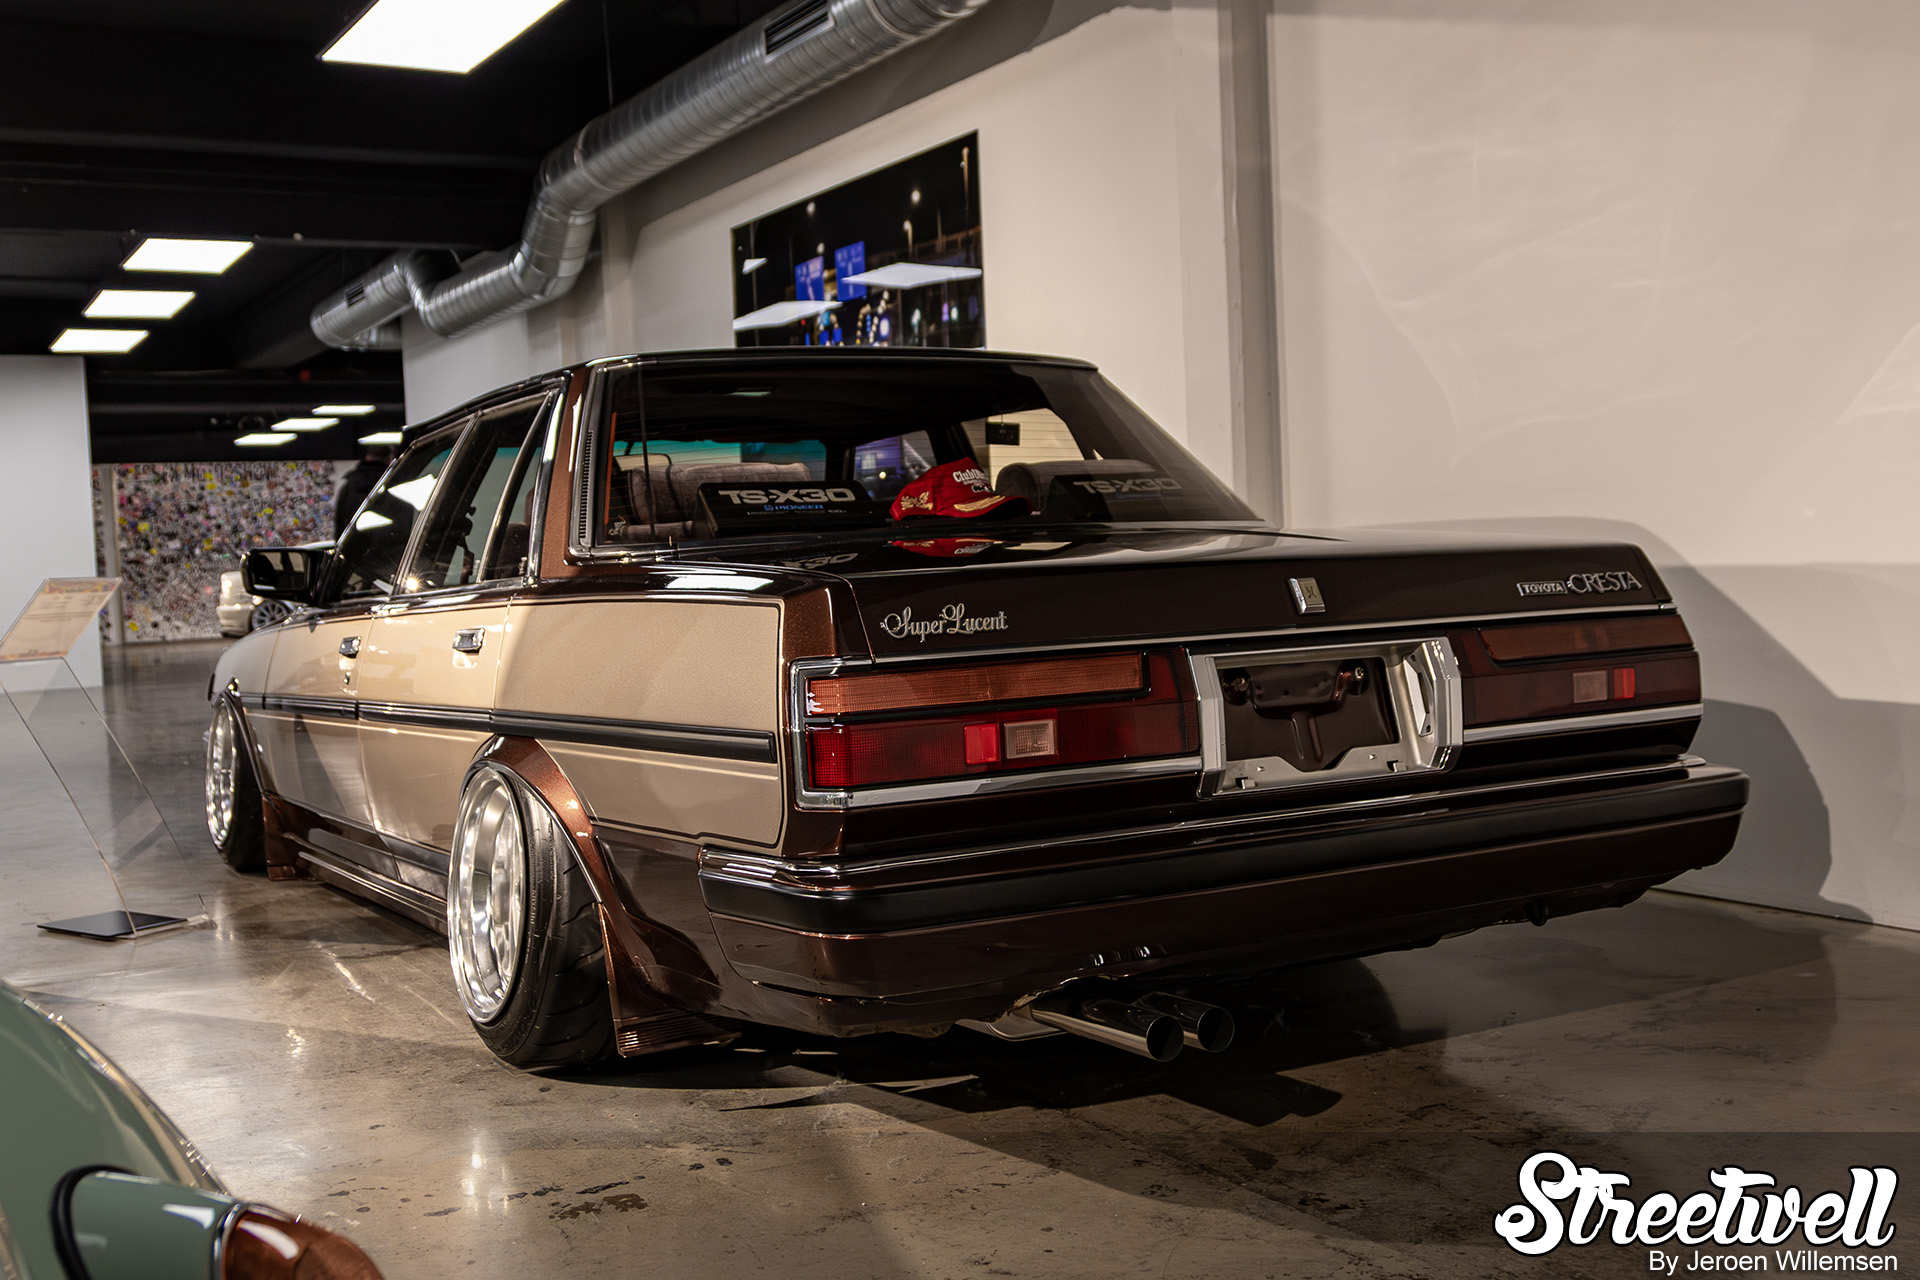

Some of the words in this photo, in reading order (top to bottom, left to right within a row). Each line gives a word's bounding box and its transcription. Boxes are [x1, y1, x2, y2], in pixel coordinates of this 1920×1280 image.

[718, 488, 856, 505] TS-X30
[1523, 583, 1564, 594] TOYOTA
[1567, 571, 1643, 594] CRESTA
[880, 606, 947, 643] Super
[939, 603, 1009, 635] Lucent
